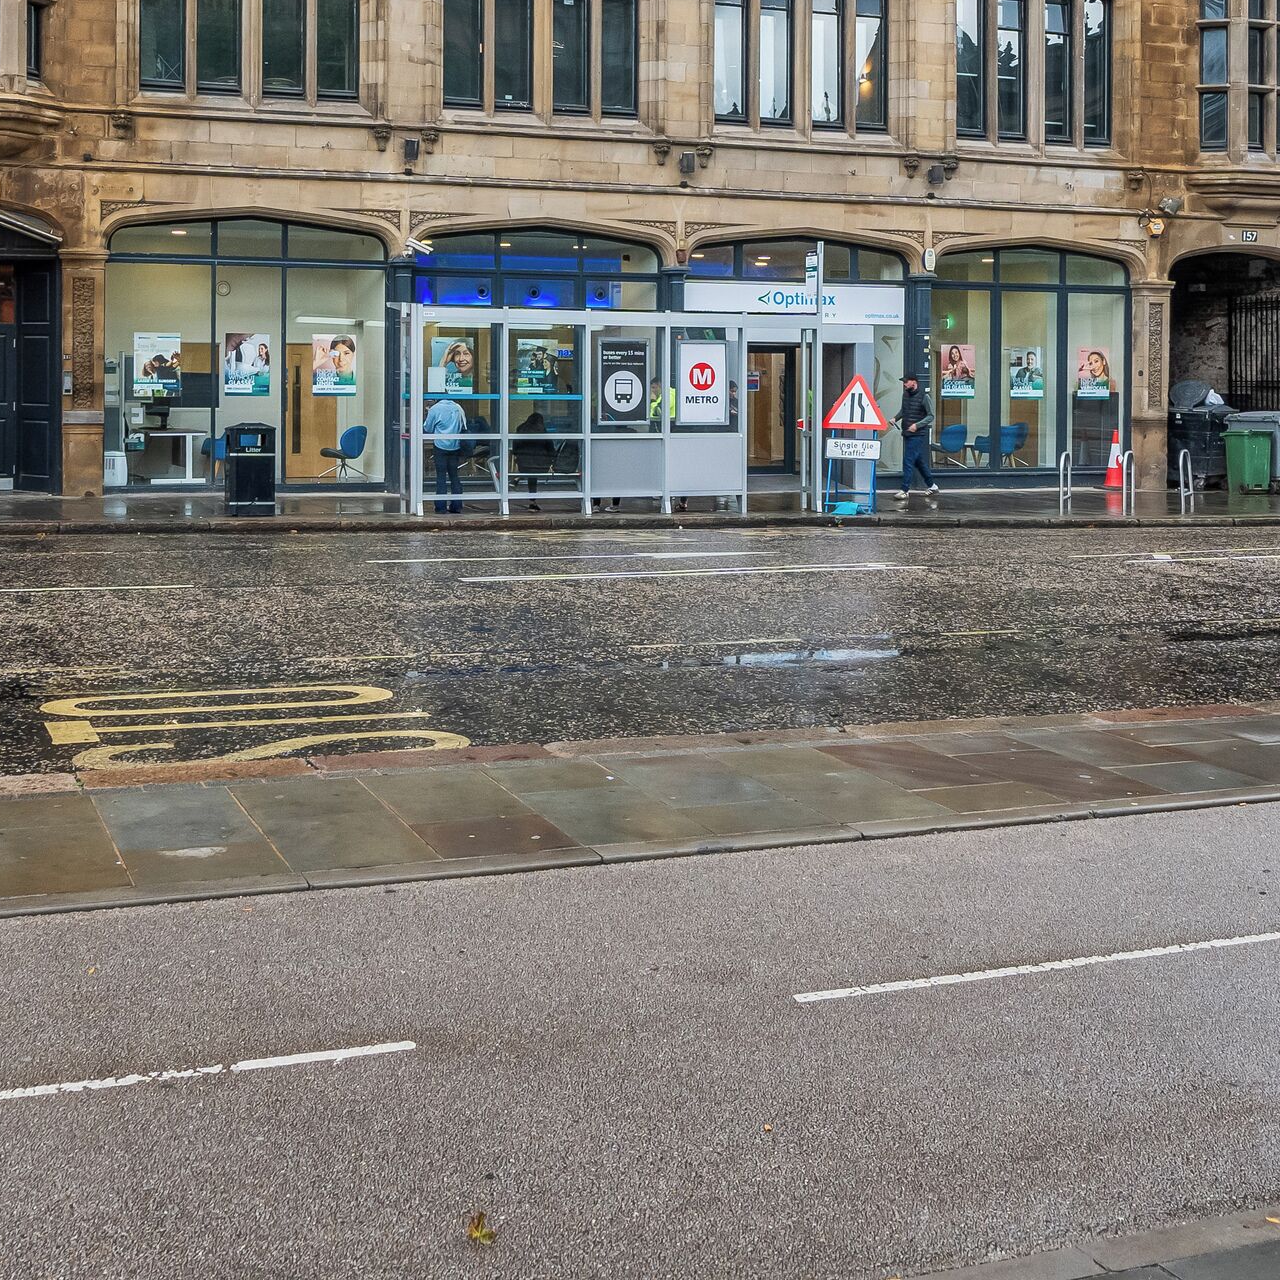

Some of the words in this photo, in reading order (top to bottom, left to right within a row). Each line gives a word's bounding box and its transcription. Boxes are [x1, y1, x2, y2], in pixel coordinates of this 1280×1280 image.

[1243, 231, 1257, 241] 157
[693, 368, 712, 385] M
[685, 395, 719, 404] METRO
[833, 441, 858, 450] Single
[861, 442, 874, 450] file
[841, 449, 865, 457] traffic
